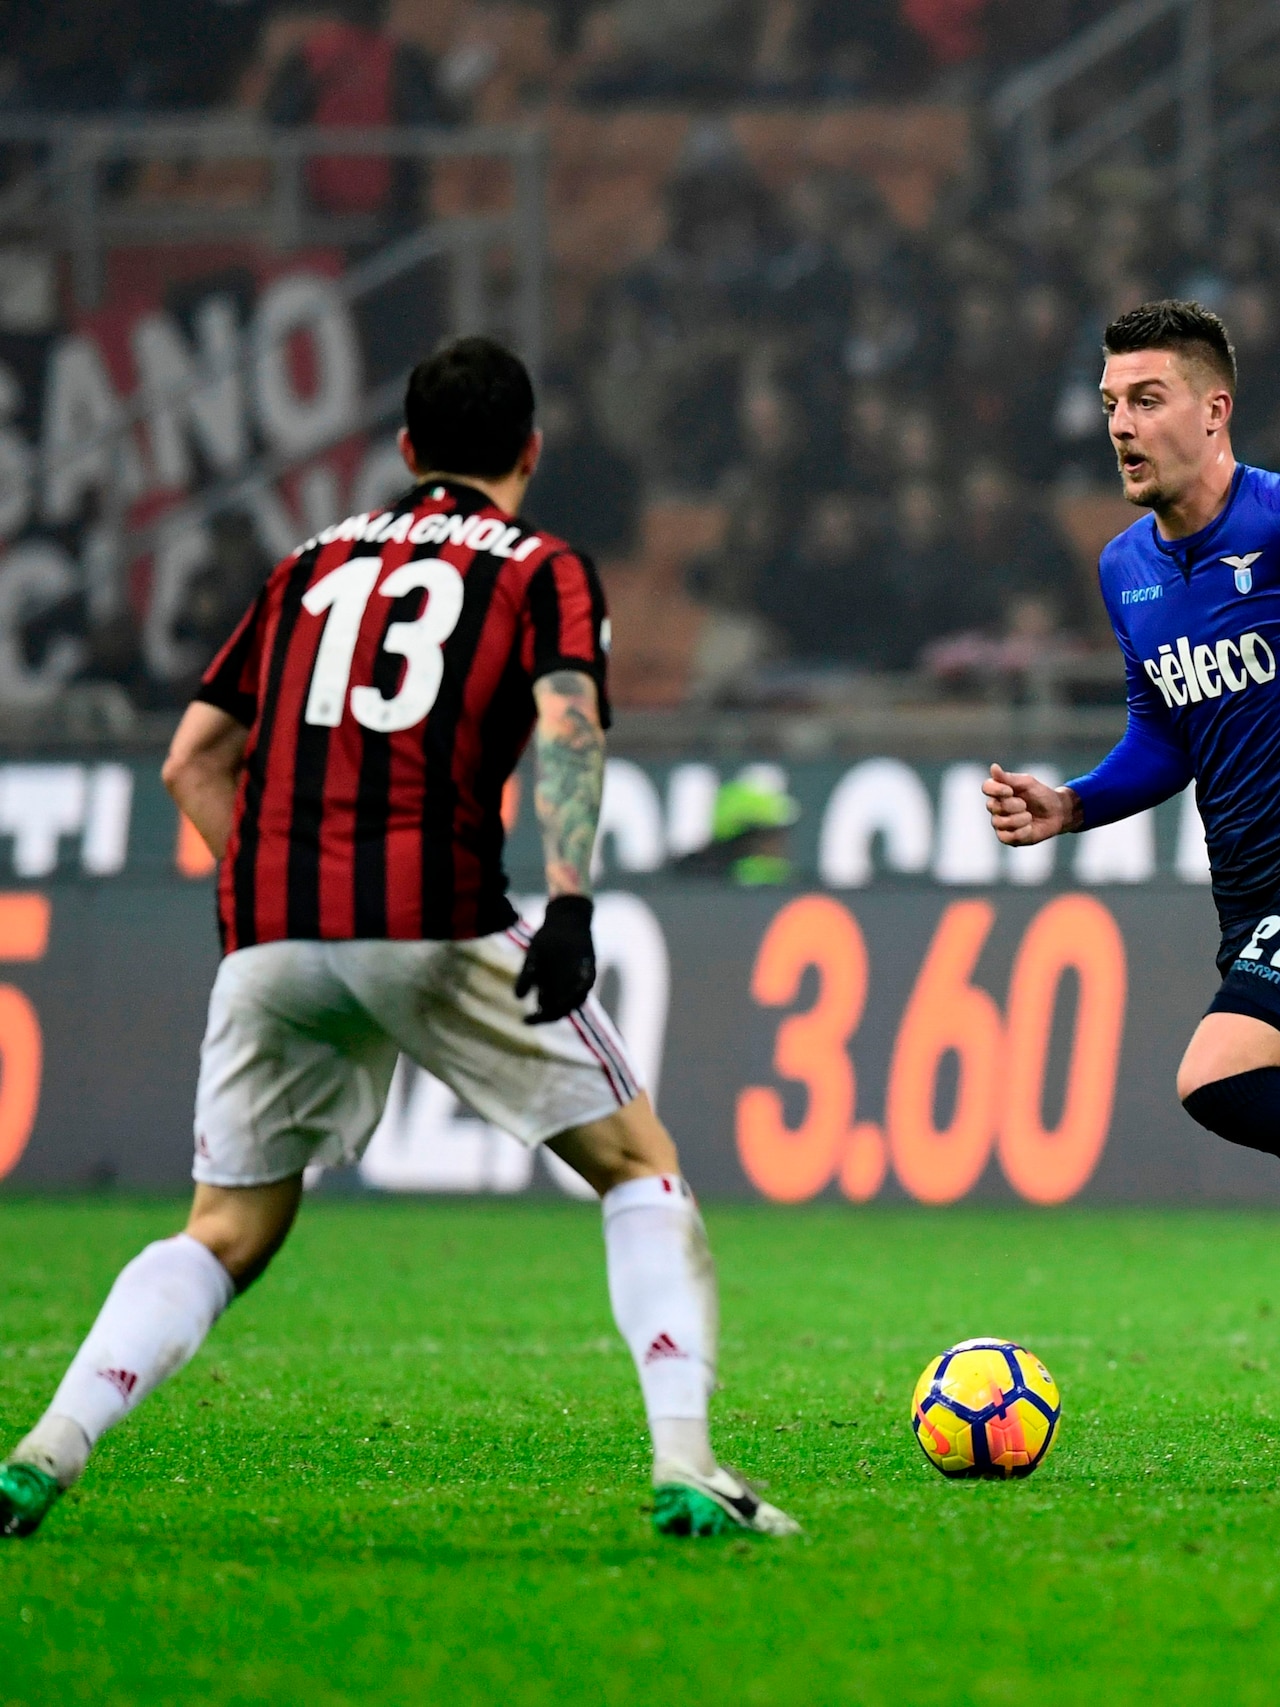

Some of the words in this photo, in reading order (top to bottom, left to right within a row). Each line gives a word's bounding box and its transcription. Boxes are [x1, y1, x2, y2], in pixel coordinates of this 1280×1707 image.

[301, 556, 464, 733] 13
[1121, 584, 1163, 605] macron
[734, 892, 1129, 1206] 3.60
